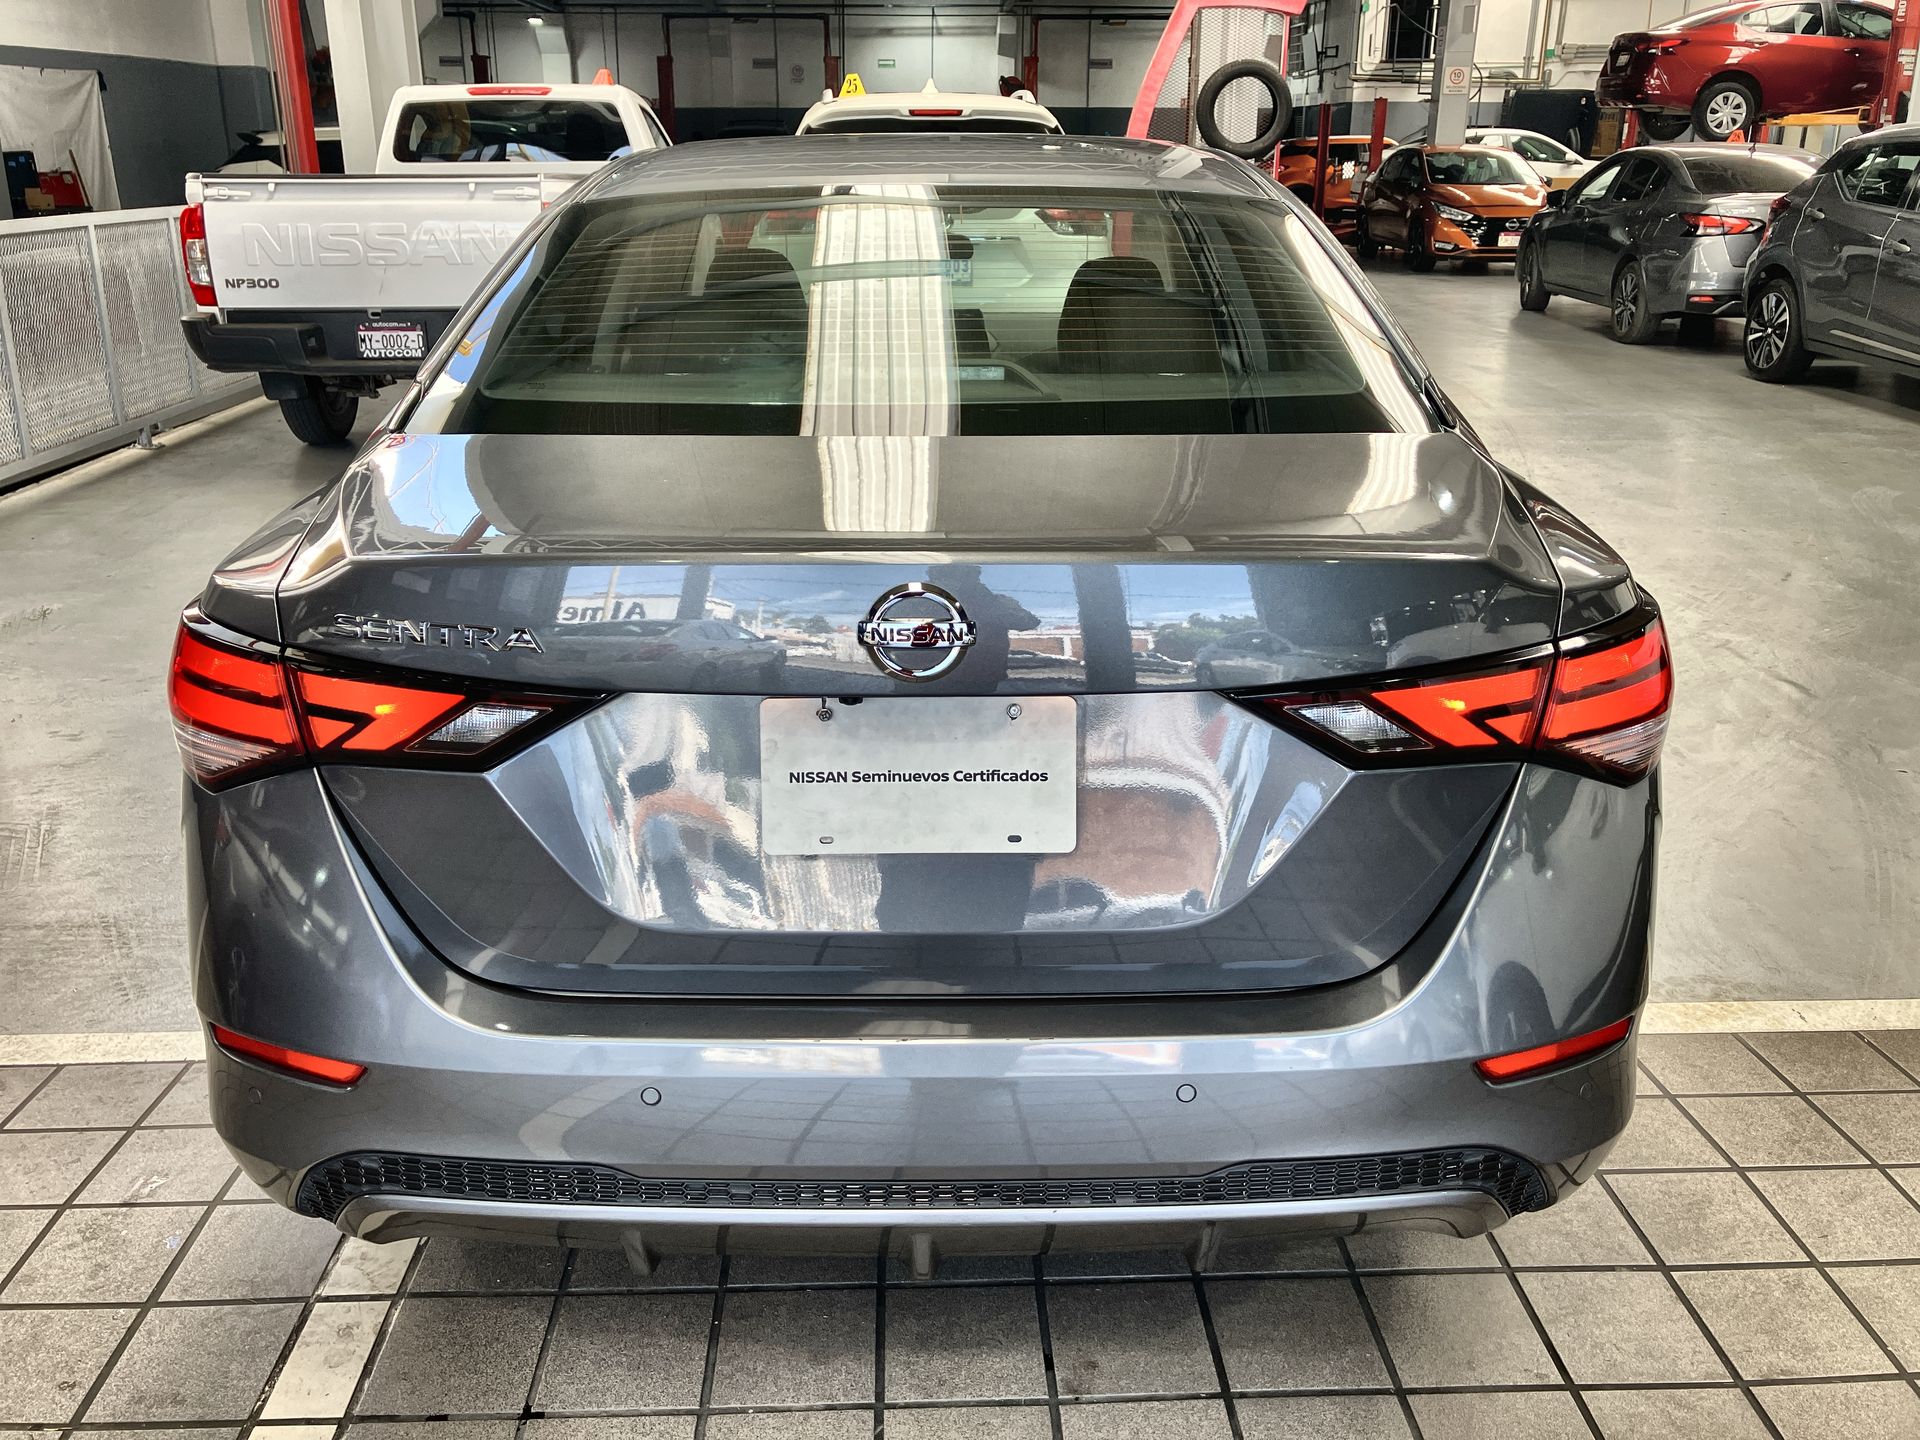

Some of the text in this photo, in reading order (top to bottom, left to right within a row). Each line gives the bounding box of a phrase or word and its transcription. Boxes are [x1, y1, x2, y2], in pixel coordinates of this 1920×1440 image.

[846, 79, 858, 94] 25
[241, 221, 507, 267] NISSAN
[225, 278, 280, 289] NP300
[363, 349, 422, 358] AUTOCOM
[333, 612, 545, 654] SENTRA
[870, 626, 964, 643] NISSAN
[789, 769, 1049, 784] NISSAN Seminuevos Certificados
